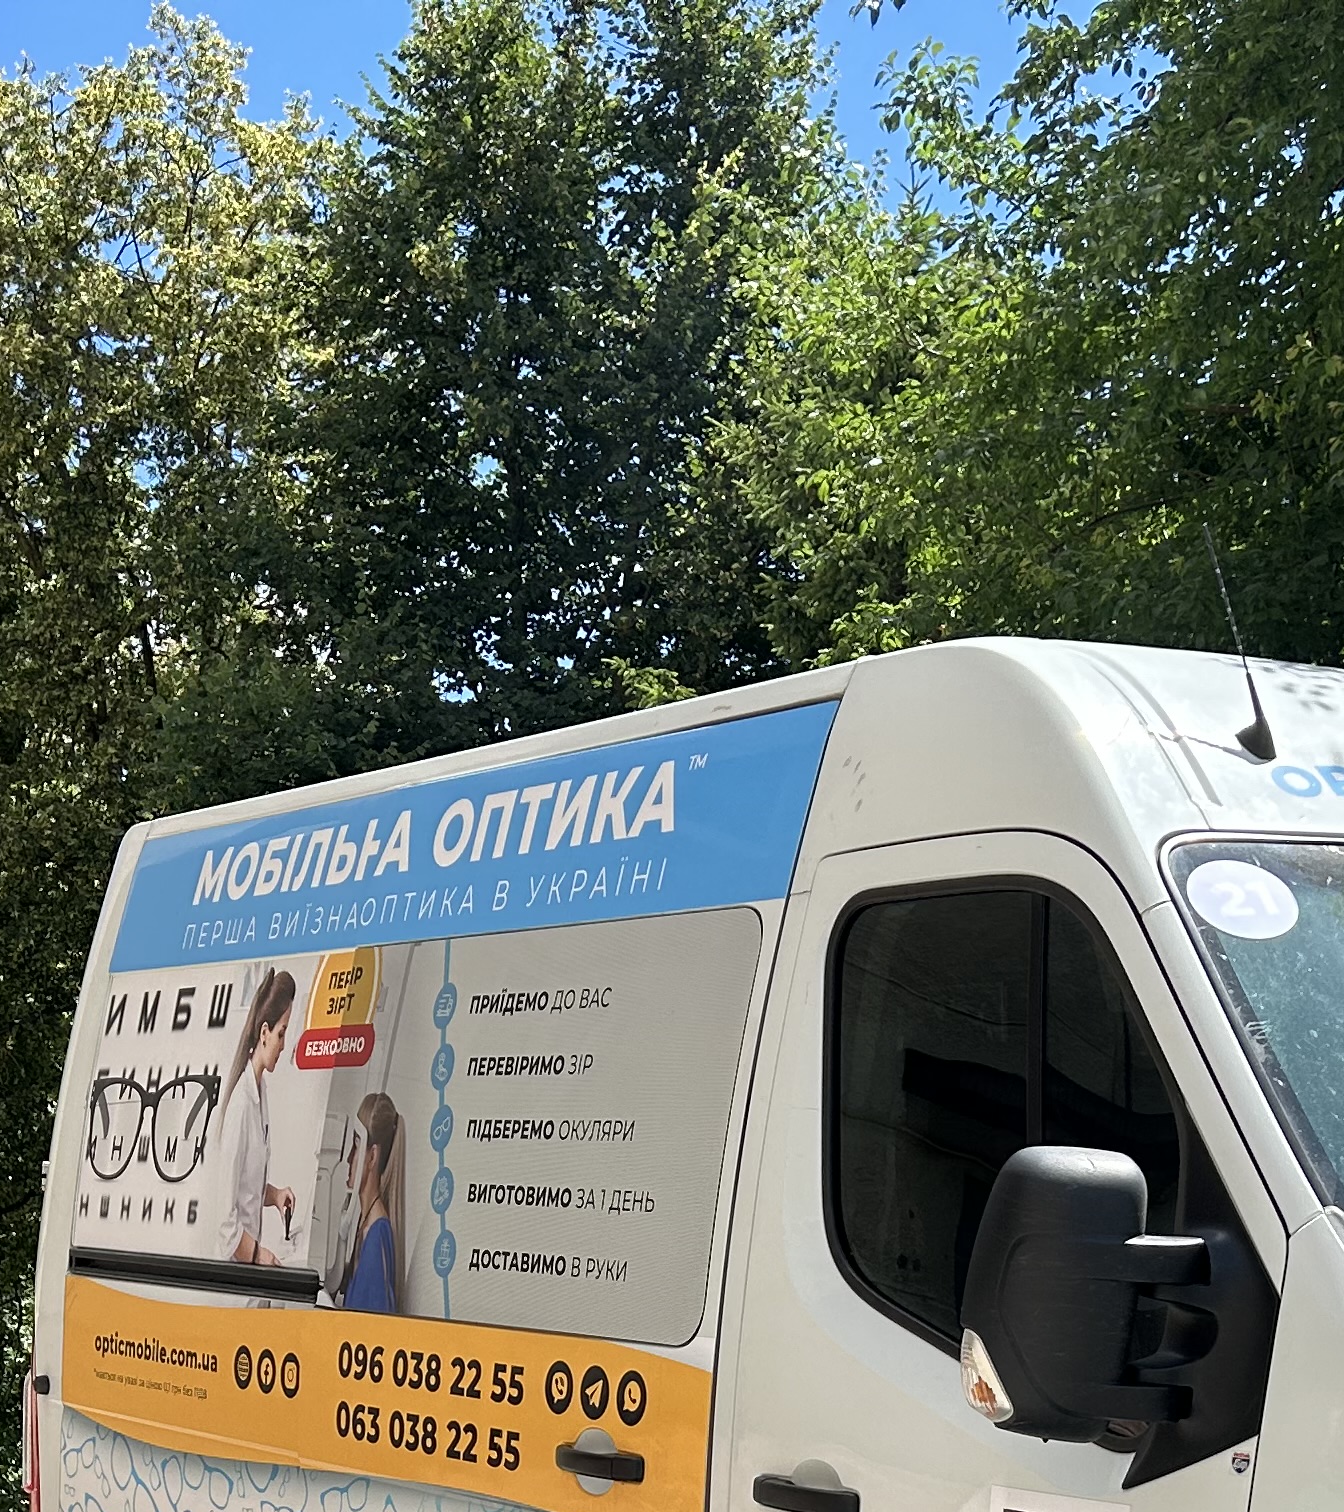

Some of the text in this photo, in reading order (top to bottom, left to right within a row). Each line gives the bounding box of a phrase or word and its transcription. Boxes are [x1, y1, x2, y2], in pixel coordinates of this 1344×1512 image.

[433, 760, 674, 867] ОПТИКА
[182, 916, 256, 950] ПЕРША
[492, 880, 510, 911] В
[526, 856, 667, 907] УКРАЇНІ
[1210, 880, 1280, 918] 21
[550, 989, 576, 1014] ДО
[579, 987, 613, 1009] ВАС
[467, 1054, 594, 1077] ПЕРЕВІРИМО ЗІР
[466, 1119, 636, 1142] ПІДБЕРЕМО ОКУЛЯРИ
[467, 1183, 655, 1216] ВИГОТОВИМО ЗА 1 ДЕНЬ
[468, 1249, 628, 1282] ДОСТАВИМО В РУКИ
[94, 1331, 218, 1373] opticmobile.com.ua
[338, 1340, 525, 1406] 096 038 22 55
[336, 1400, 520, 1471] 063 038 22 55
